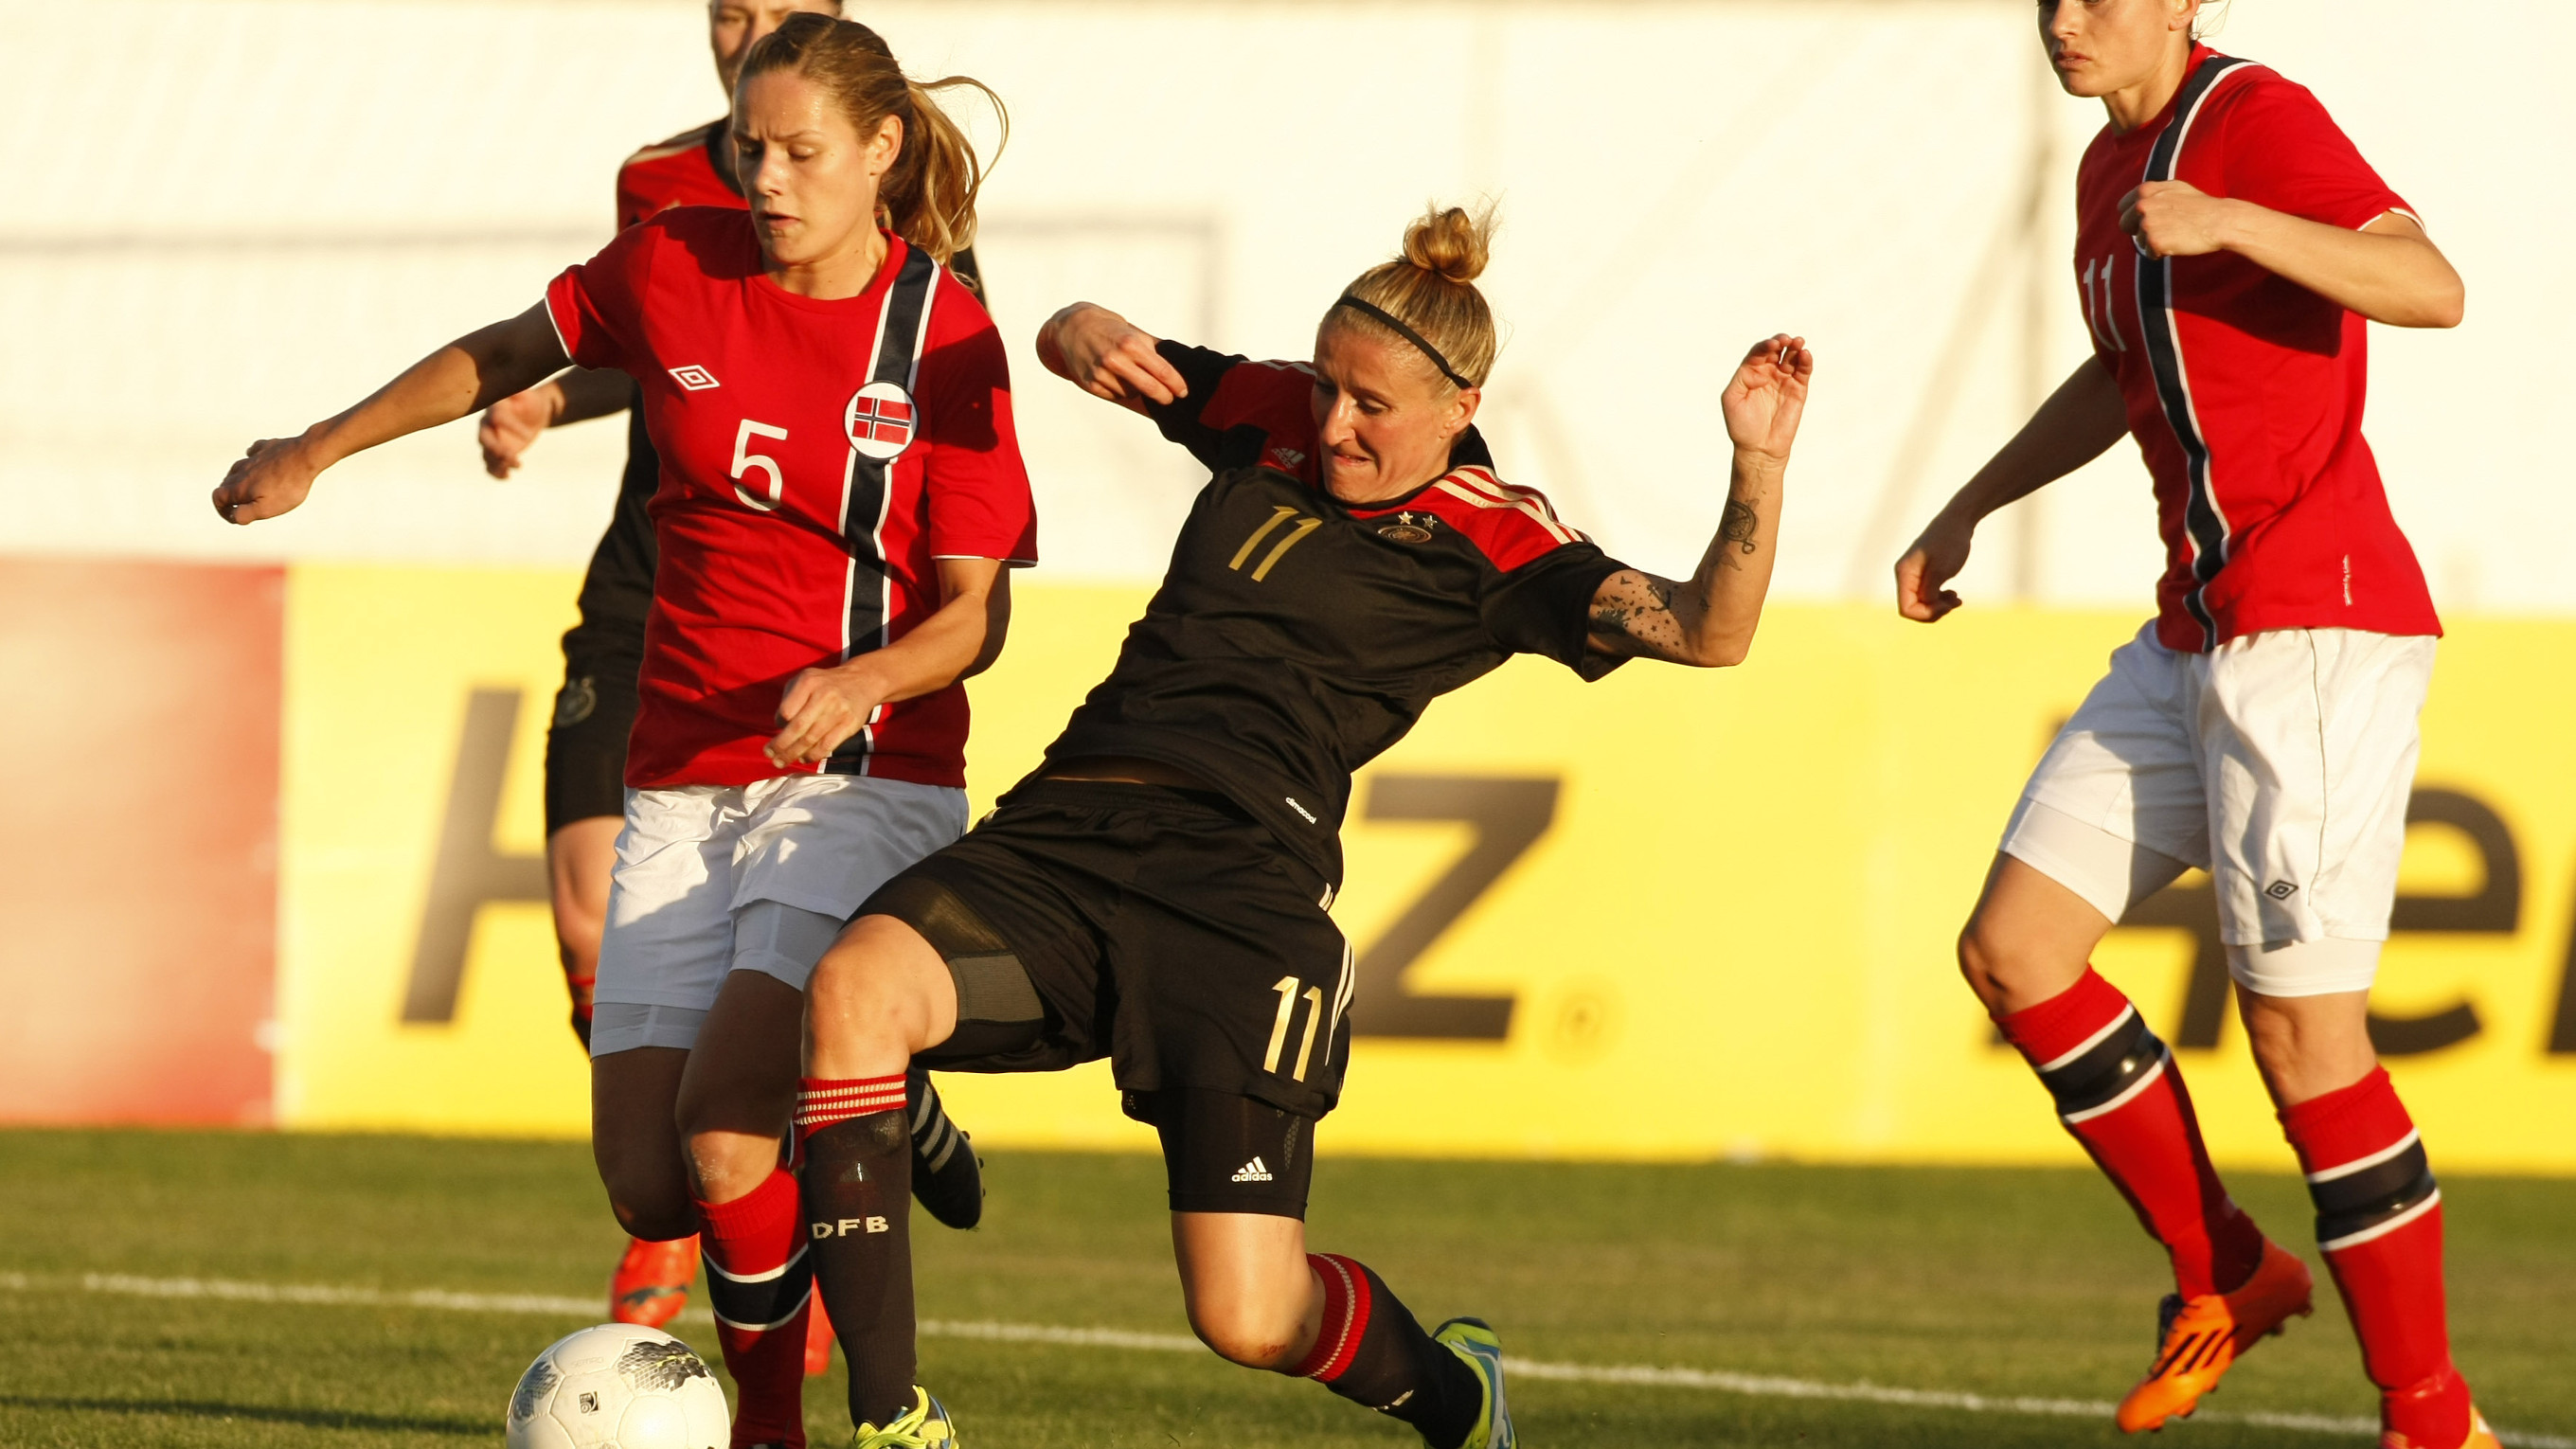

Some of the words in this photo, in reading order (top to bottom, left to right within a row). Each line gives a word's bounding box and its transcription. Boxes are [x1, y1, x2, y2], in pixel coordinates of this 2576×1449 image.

[2083, 254, 2127, 352] 11
[730, 419, 789, 511] 5
[1228, 505, 1323, 582] 11
[1285, 796, 1317, 824] climacool
[1262, 975, 1322, 1082] 11
[1231, 1171, 1273, 1182] adidas
[812, 1216, 889, 1240] DFB
